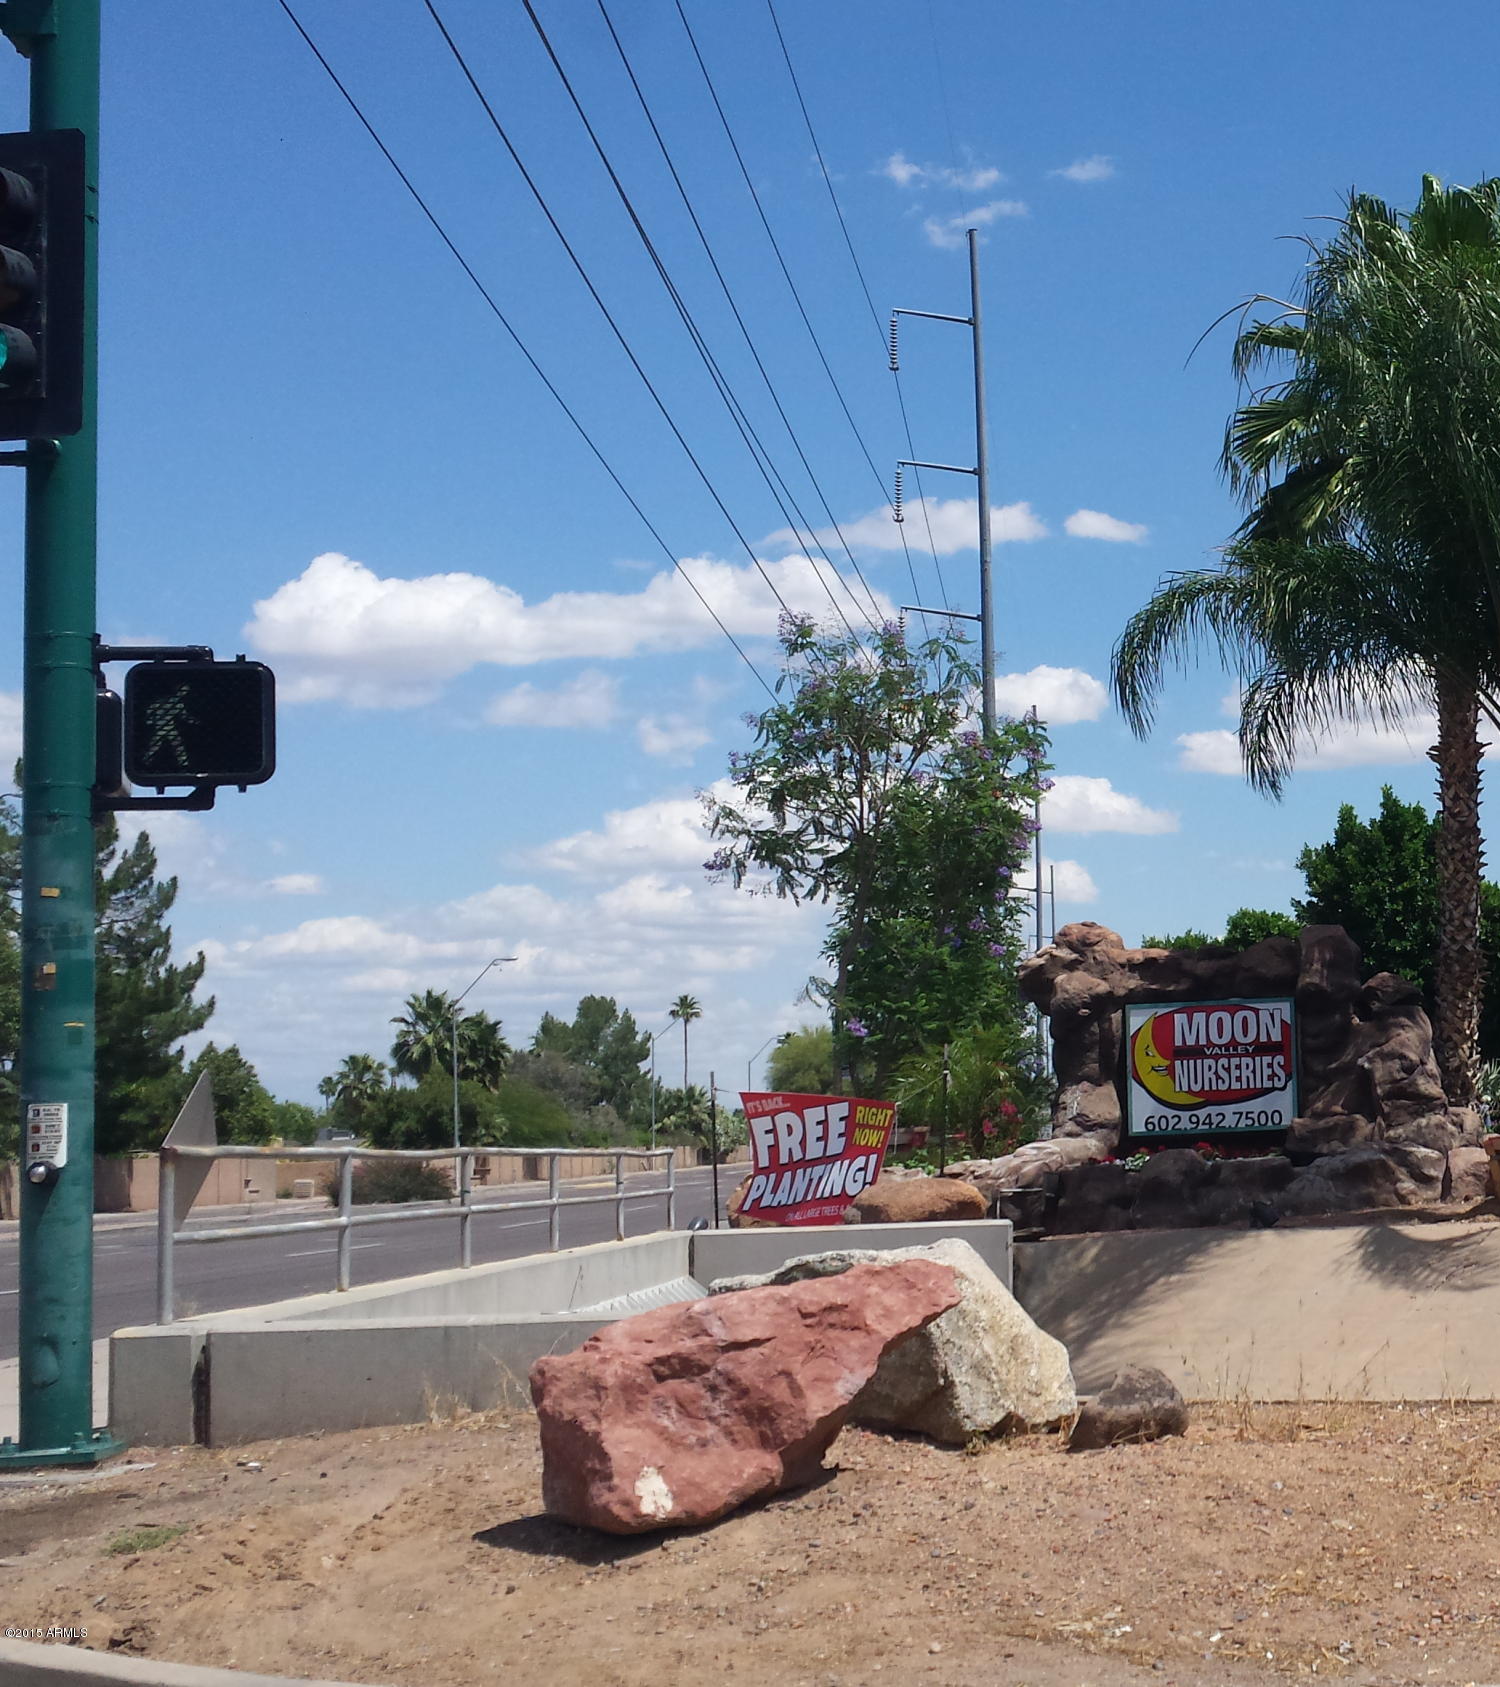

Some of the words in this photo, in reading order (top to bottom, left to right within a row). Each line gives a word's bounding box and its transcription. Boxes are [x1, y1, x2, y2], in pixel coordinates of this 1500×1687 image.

[1173, 1009, 1283, 1047] MOON
[1204, 1045, 1255, 1056] VALLEY
[1174, 1054, 1287, 1093] NURSERIES
[745, 1100, 762, 1114] IT'S
[855, 1105, 894, 1128] RIGHT
[1144, 1109, 1283, 1132] 602.942.7500
[750, 1101, 849, 1169] FREE
[852, 1127, 885, 1149] NOW!
[741, 1153, 878, 1212] PLANTING!
[821, 1205, 839, 1217] TREES
